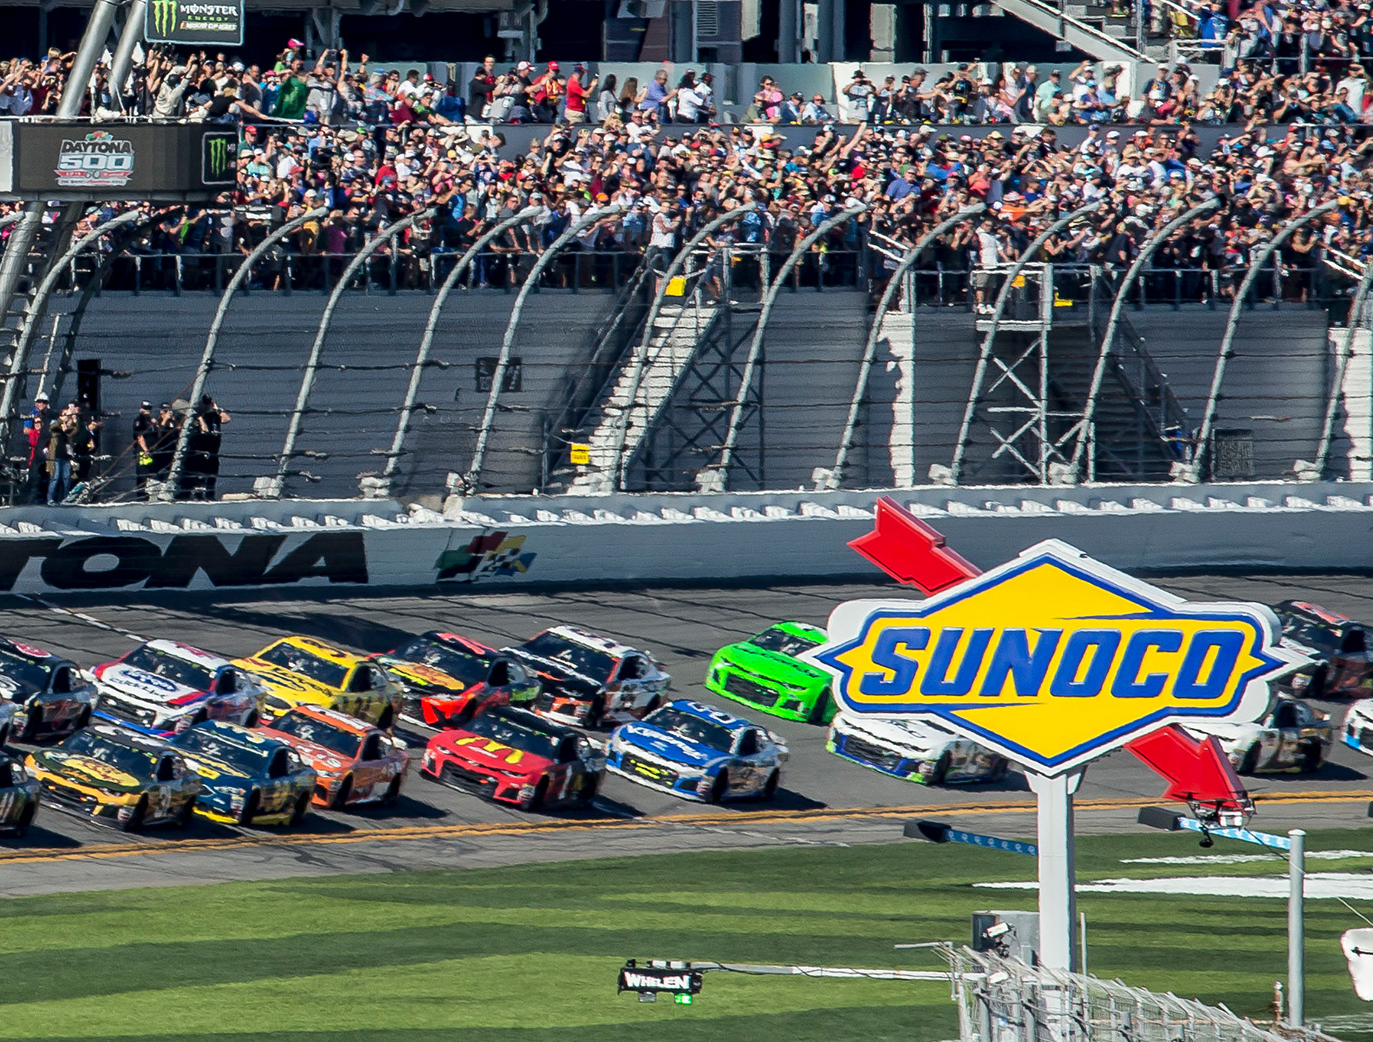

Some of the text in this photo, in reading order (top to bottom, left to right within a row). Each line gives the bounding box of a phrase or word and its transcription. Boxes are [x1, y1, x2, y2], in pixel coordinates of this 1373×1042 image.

[180, 4, 238, 16] MONSTER
[61, 139, 134, 153] DAYTONA
[60, 154, 132, 170] 500
[858, 626, 1246, 699] SUNOCO
[624, 971, 690, 990] WHELEN
